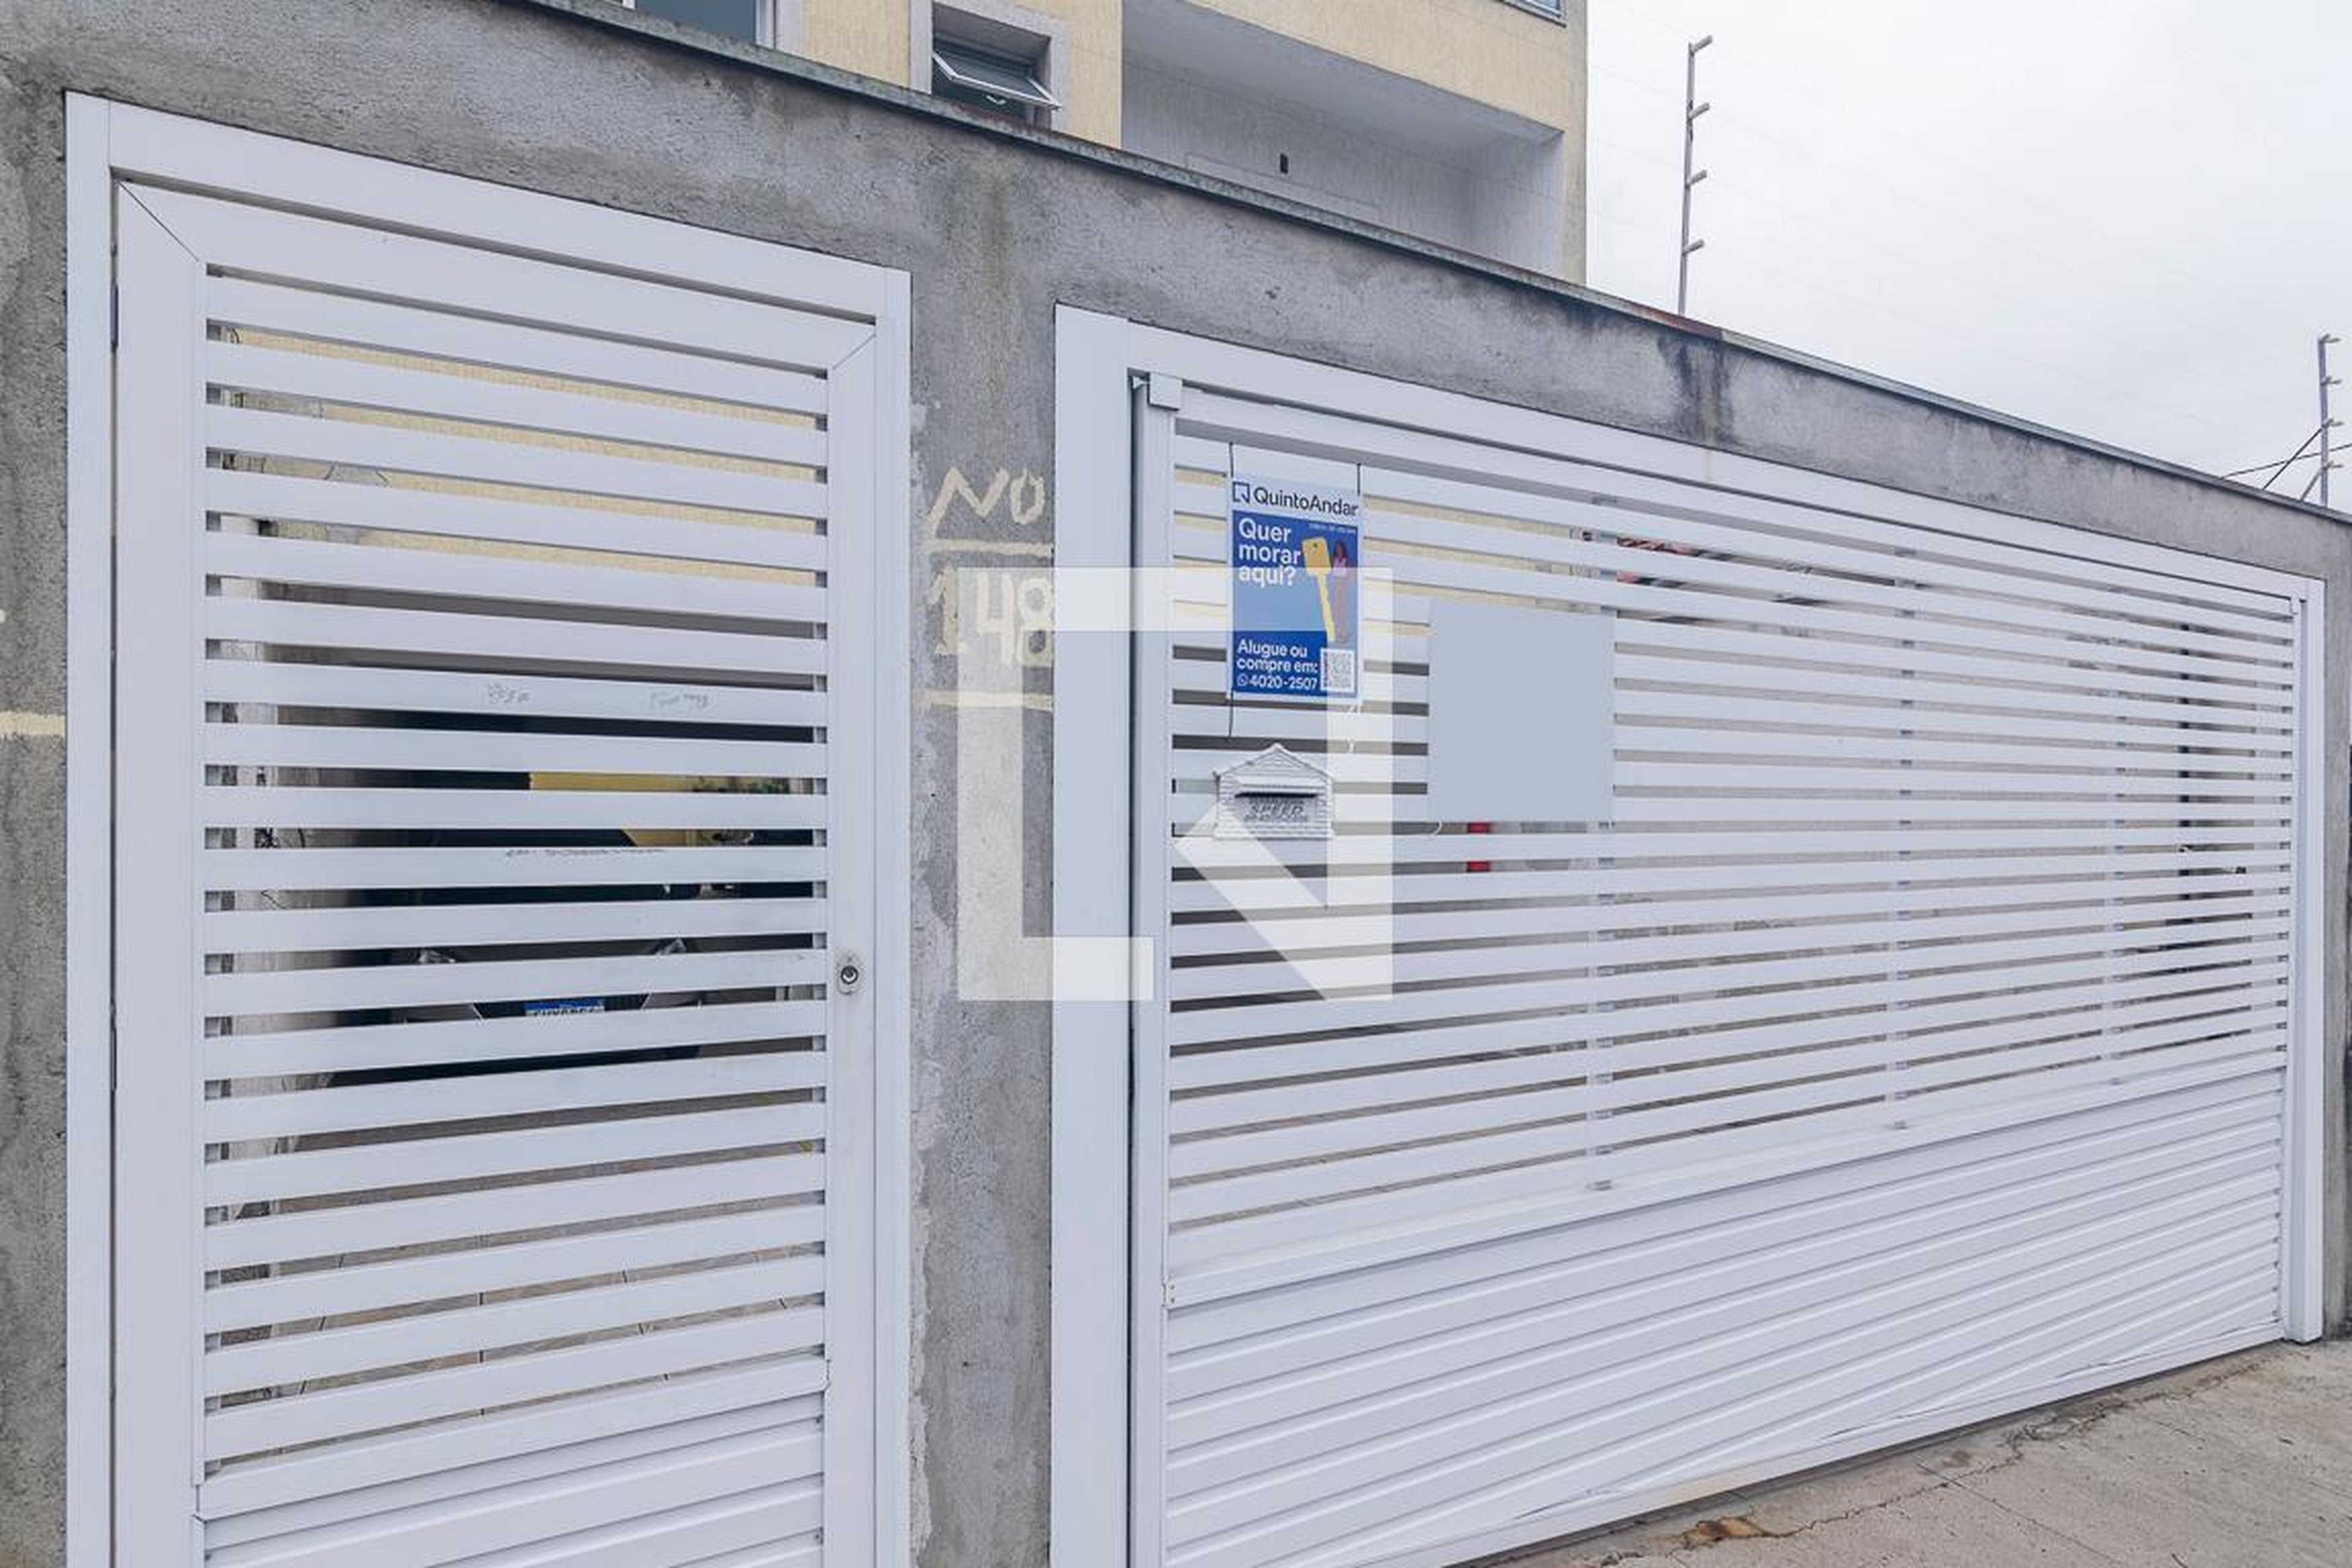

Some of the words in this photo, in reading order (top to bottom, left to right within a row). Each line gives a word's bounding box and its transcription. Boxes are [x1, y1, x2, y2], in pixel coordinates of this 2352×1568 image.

[1253, 487, 1359, 516] QuintoAndar
[1238, 518, 1291, 542] Quer
[1238, 543, 1302, 564] morar
[1238, 565, 1297, 588] aqui?
[925, 560, 1052, 668] 148
[1237, 639, 1287, 658] Alugue
[1289, 646, 1308, 658] ou
[1237, 657, 1291, 674] compre
[1294, 664, 1318, 674] em:
[1250, 674, 1317, 690] 4020-2507
